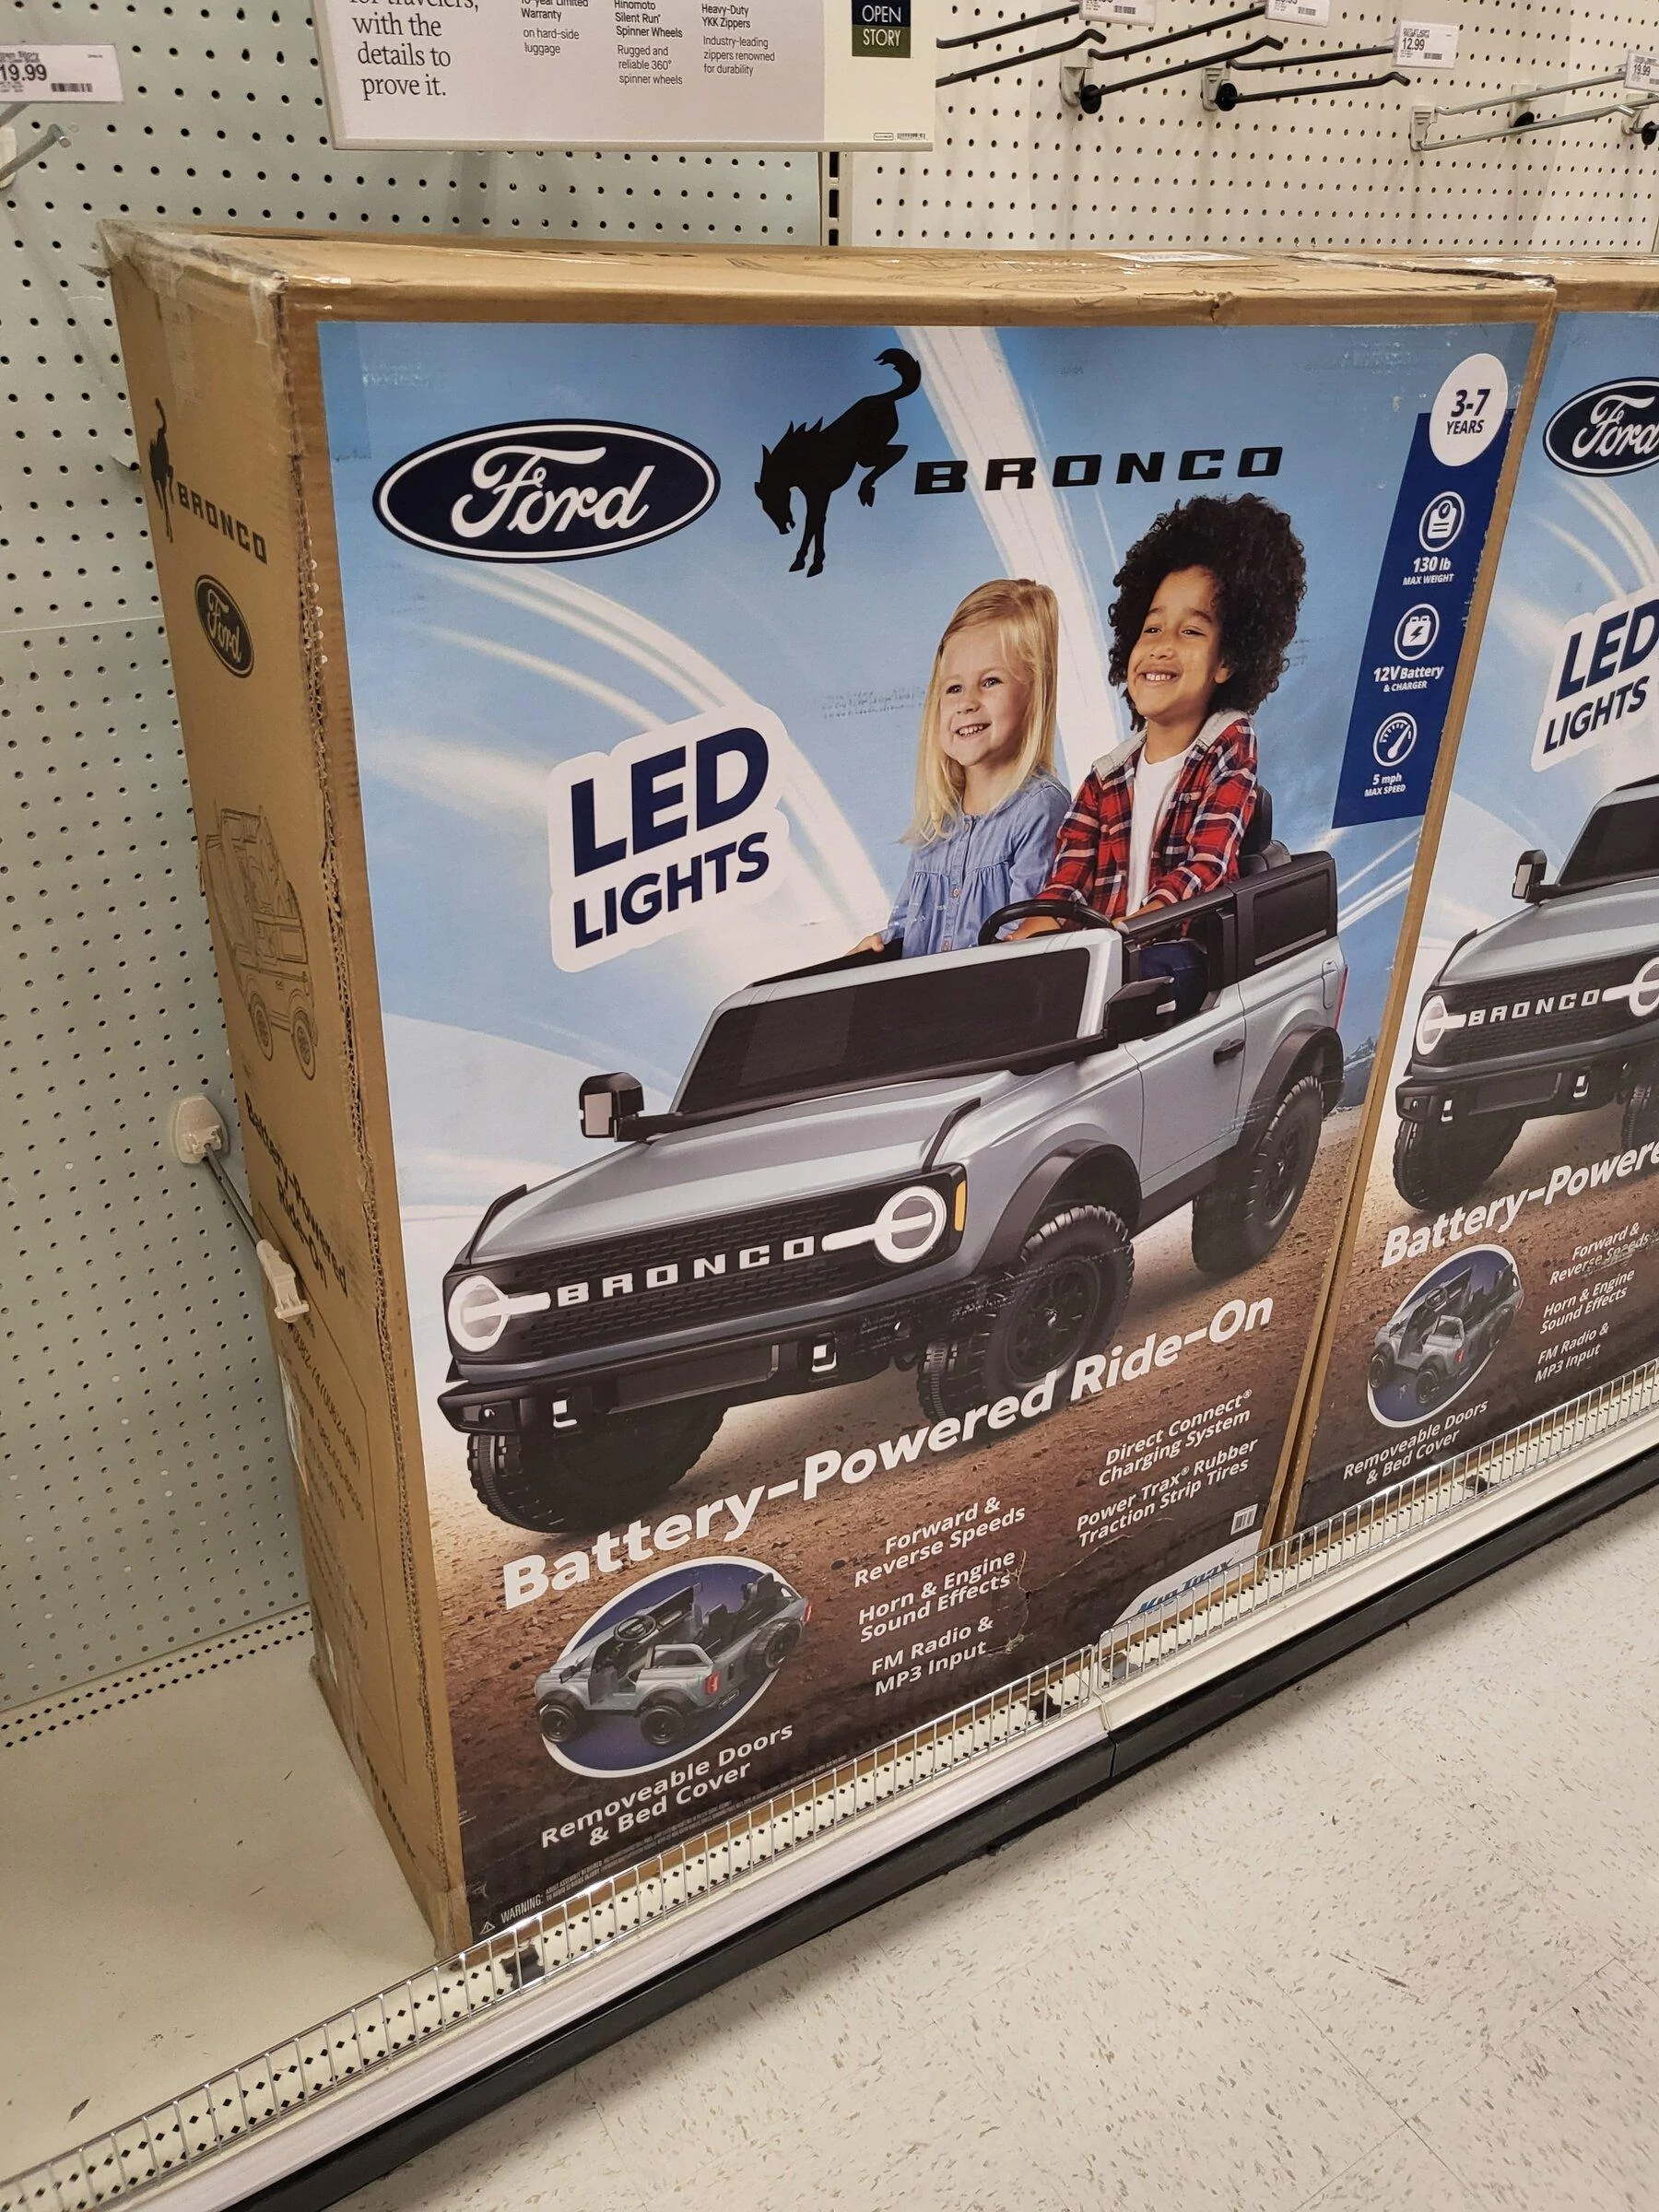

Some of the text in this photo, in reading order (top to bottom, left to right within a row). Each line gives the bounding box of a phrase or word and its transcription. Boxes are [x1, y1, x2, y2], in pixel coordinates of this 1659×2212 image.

[352, 12, 441, 37] with the
[521, 7, 562, 22] Warranty
[615, 12, 641, 23] Silent
[701, 4, 749, 18] Heavy-Duty
[701, 17, 751, 30] YKK Zippers
[862, 5, 901, 23] OPEN
[524, 28, 580, 40] on hard-side
[524, 42, 561, 56] luggage
[616, 25, 683, 38] Spinner Wheels
[618, 44, 669, 58] Rugged and
[703, 35, 769, 50] Industry-leading
[863, 28, 901, 47] STORY
[1403, 38, 1425, 51] 12.99
[0, 64, 47, 81] 19.99
[358, 41, 451, 67] details to
[618, 59, 672, 71] reliable 360°
[703, 50, 775, 62] zippers renowned
[704, 64, 754, 77] for durability
[361, 74, 446, 101] prove it.
[619, 74, 683, 86] spinner wheels
[1451, 388, 1490, 418] 3-7
[1446, 419, 1485, 435] YEARS
[914, 446, 1282, 495] BRONCO
[452, 444, 655, 538] Ford
[177, 481, 268, 566] BRONCO
[1403, 573, 1453, 586] MAX WEIGHT
[1413, 556, 1452, 573] 130 lb
[1556, 599, 1659, 702] LED
[1373, 665, 1444, 682] 12V Battery
[1383, 680, 1427, 692] & CHARGER
[1543, 676, 1651, 754] LIGHTS
[1364, 784, 1406, 796] MAX SPEED
[1372, 772, 1402, 785] 5 mph
[571, 727, 770, 877] LED
[573, 831, 770, 948] LIGHTS
[1467, 988, 1600, 1027] BRONCO
[1549, 1232, 1650, 1285] Reverse Speeds
[1571, 1222, 1640, 1261] Forward &
[557, 1235, 815, 1308] BRONCO
[1540, 1287, 1628, 1335] Sound Effects
[1543, 1270, 1635, 1318] Horn & Engine
[1535, 1343, 1601, 1382] MP3 Input
[1537, 1322, 1610, 1364] FM Radio &
[1106, 1389, 1253, 1466] Direct Connect®
[1343, 1400, 1488, 1480] Removeable Doors
[504, 1369, 1057, 1610] Battery-Powered
[1068, 1297, 1274, 1402] Ride-On
[1099, 1409, 1251, 1487] Charging System
[1366, 1430, 1460, 1486] & Bed Cover
[1077, 1439, 1258, 1531] Power Trax® Rubber
[1078, 1458, 1249, 1547] Traction Strip Tires
[886, 1497, 1001, 1555] Forward &
[854, 1506, 1026, 1588] Reverse Speeds
[858, 1551, 1016, 1625] Horn & Engine
[860, 1572, 1011, 1642] Sound Effects
[871, 1616, 994, 1675] FM Radio &
[875, 1641, 986, 1696] MP3 Input
[542, 1760, 710, 1848] Removeable
[718, 1724, 793, 1768] Doors
[590, 1827, 609, 1846] &
[618, 1795, 667, 1833] Bed
[676, 1761, 751, 1805] Cover
[500, 1893, 544, 1924] WARNING:
